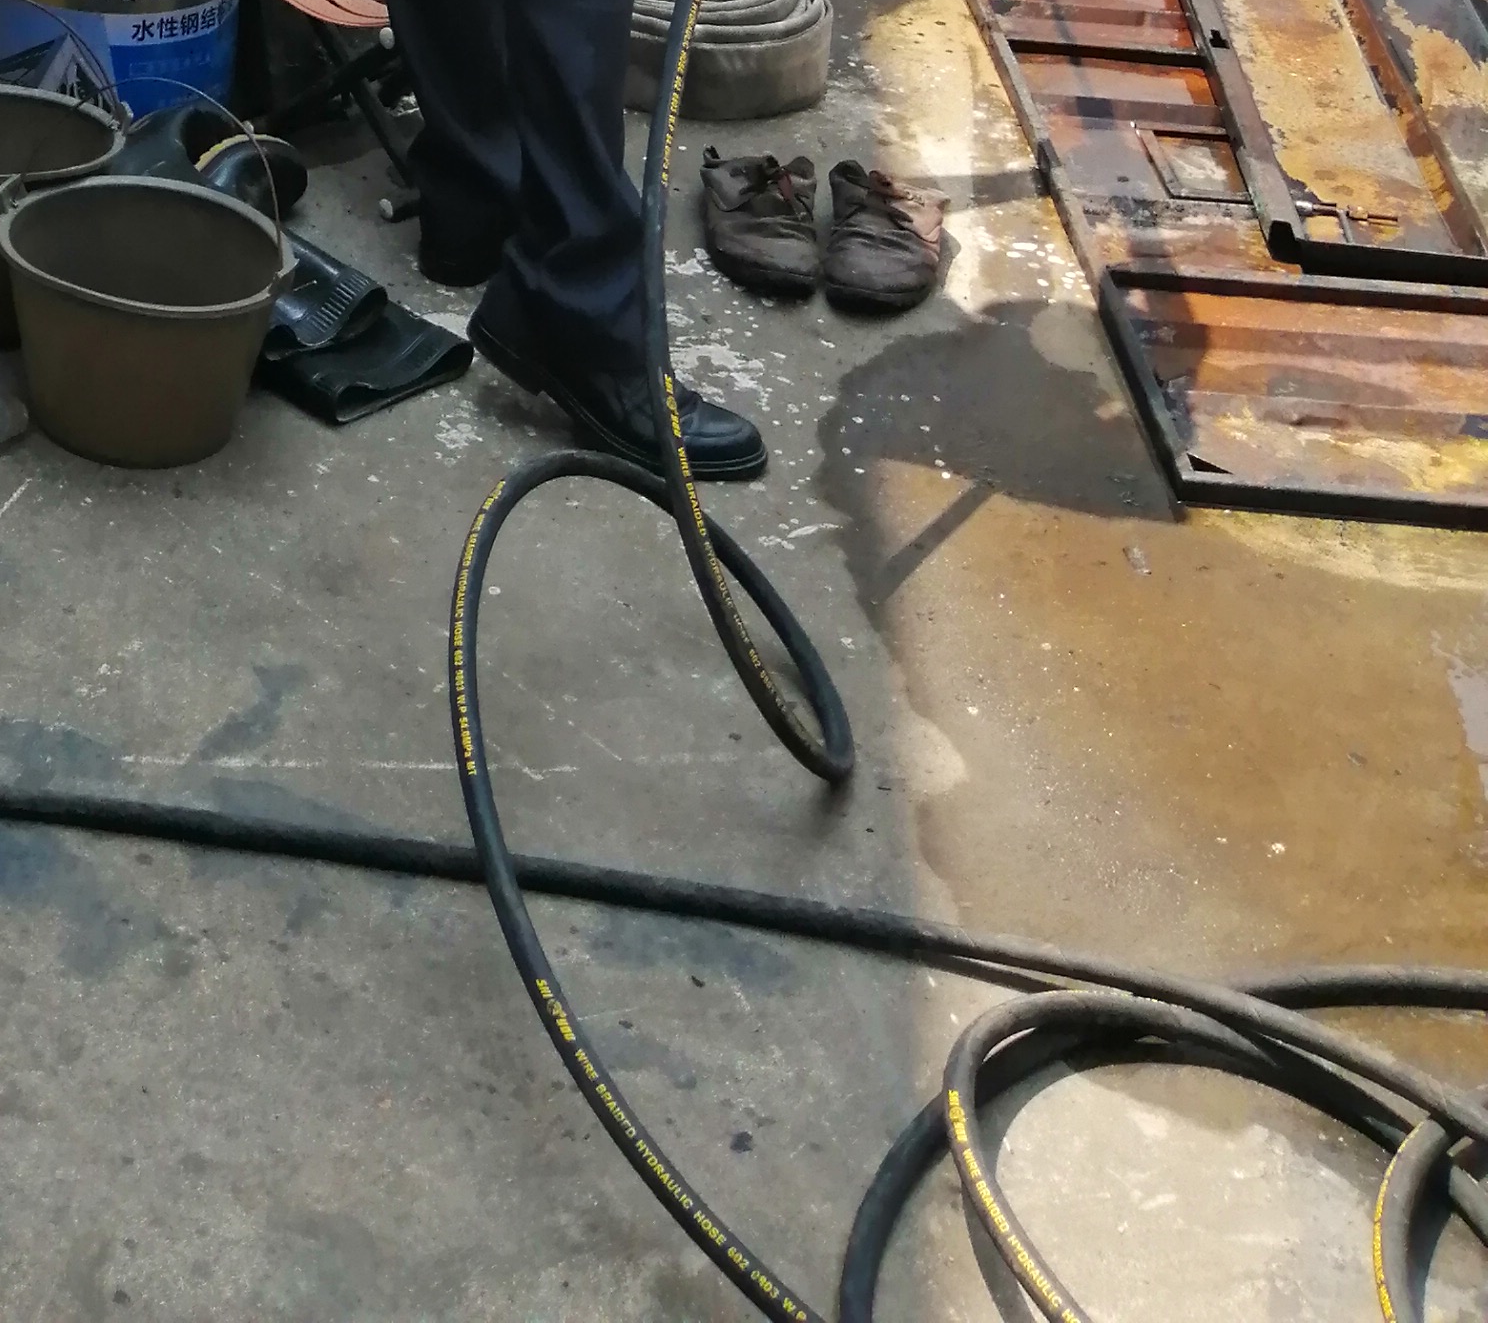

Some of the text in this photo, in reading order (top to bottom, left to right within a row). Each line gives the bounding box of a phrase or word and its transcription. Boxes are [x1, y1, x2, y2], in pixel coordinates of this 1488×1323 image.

[677, 446, 692, 477] WIRE
[685, 482, 707, 537] BRAIDED
[454, 620, 464, 647] HOSE
[575, 1048, 599, 1082] WIRE
[595, 1083, 637, 1139] BRAIDED
[635, 1139, 694, 1210] HYDRAULIC
[693, 1210, 727, 1247] HOSE
[727, 1246, 750, 1271] 602
[963, 1147, 982, 1179] WIRE
[975, 1180, 1010, 1234] BRAIDED
[1008, 1234, 1063, 1308] HYDRAULIC
